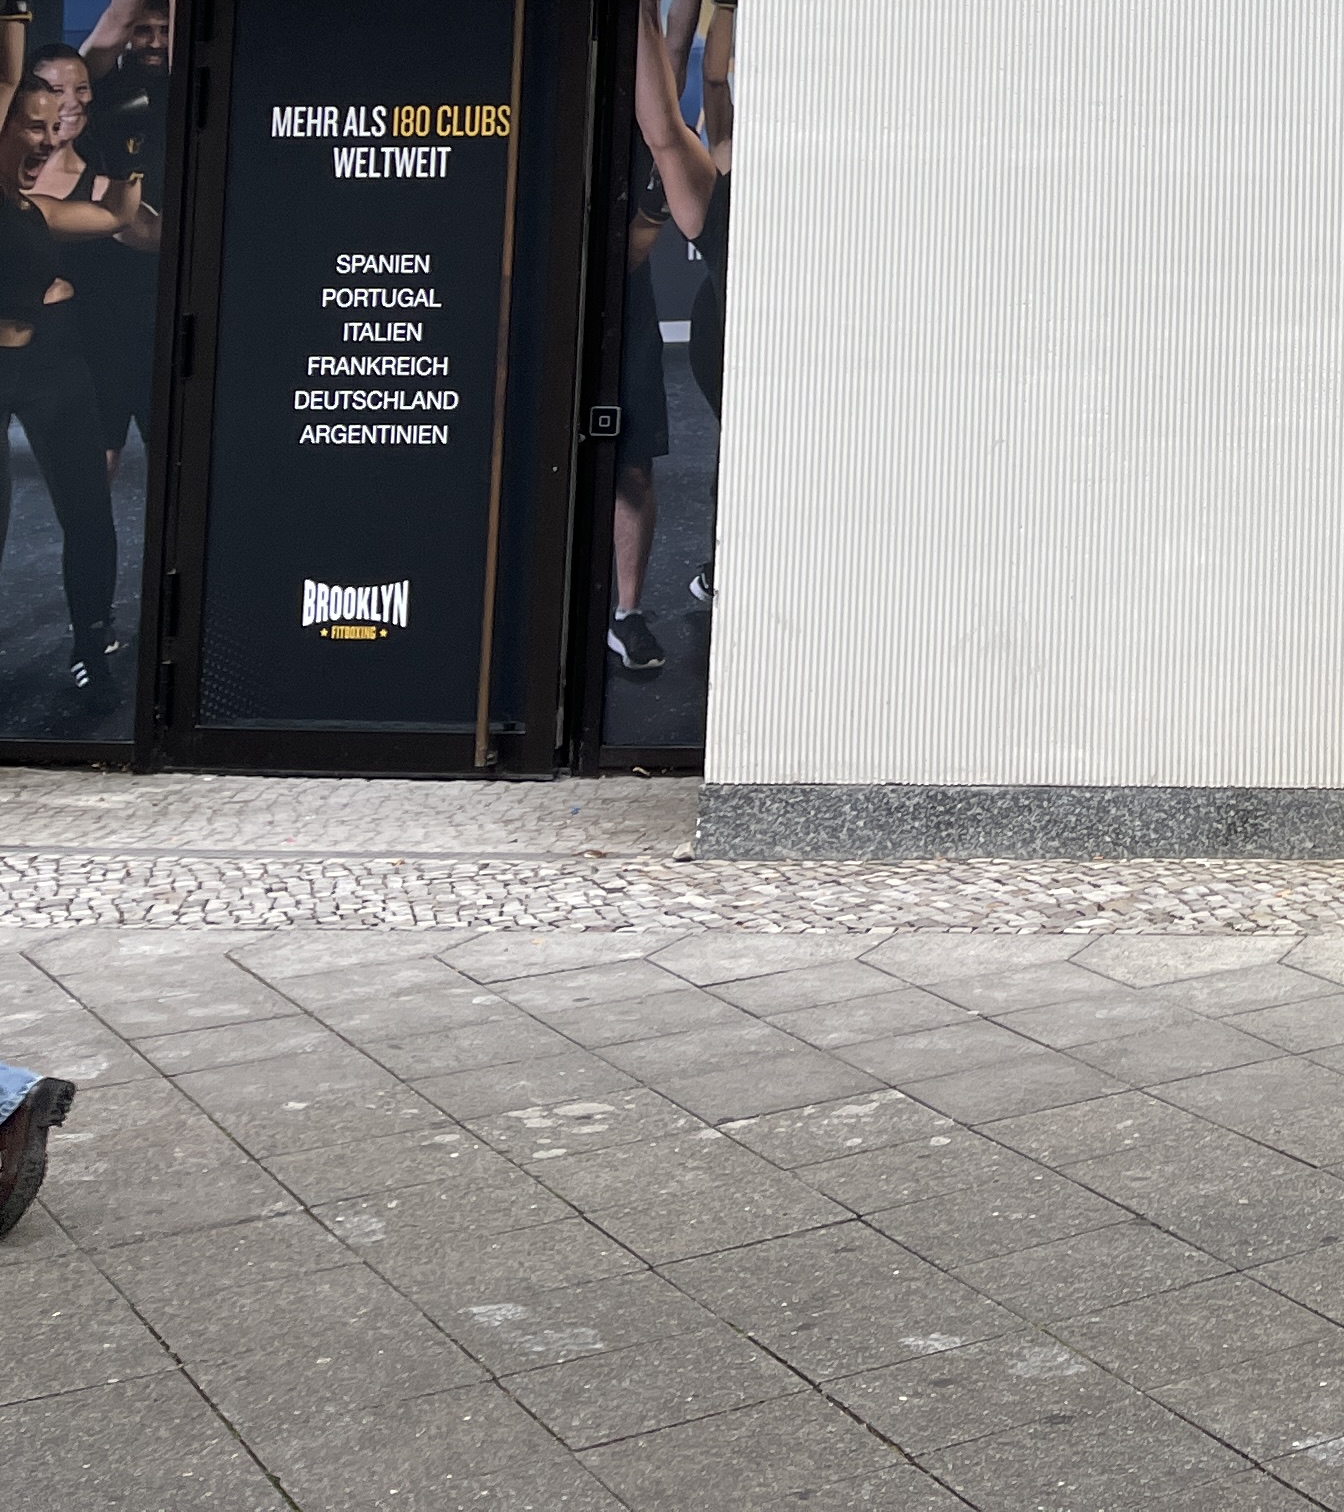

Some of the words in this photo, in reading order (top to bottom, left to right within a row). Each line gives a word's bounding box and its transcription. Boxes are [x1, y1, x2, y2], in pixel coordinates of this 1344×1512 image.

[271, 106, 338, 137] MEHR
[343, 105, 387, 137] ALS
[392, 105, 430, 137] 180
[437, 105, 511, 136] CLUBS
[333, 146, 451, 178] WELTWEIT
[336, 254, 430, 274] SPANIEN
[322, 288, 442, 308] PORTUGAL
[343, 322, 423, 342] ITALIEN
[308, 356, 449, 376] FRANKREICH
[294, 390, 459, 410] DEUTSCHLAND
[300, 424, 448, 444] ARGENTINIEN
[302, 579, 409, 628] BROOKLYN
[331, 625, 377, 640] FITBOXING
